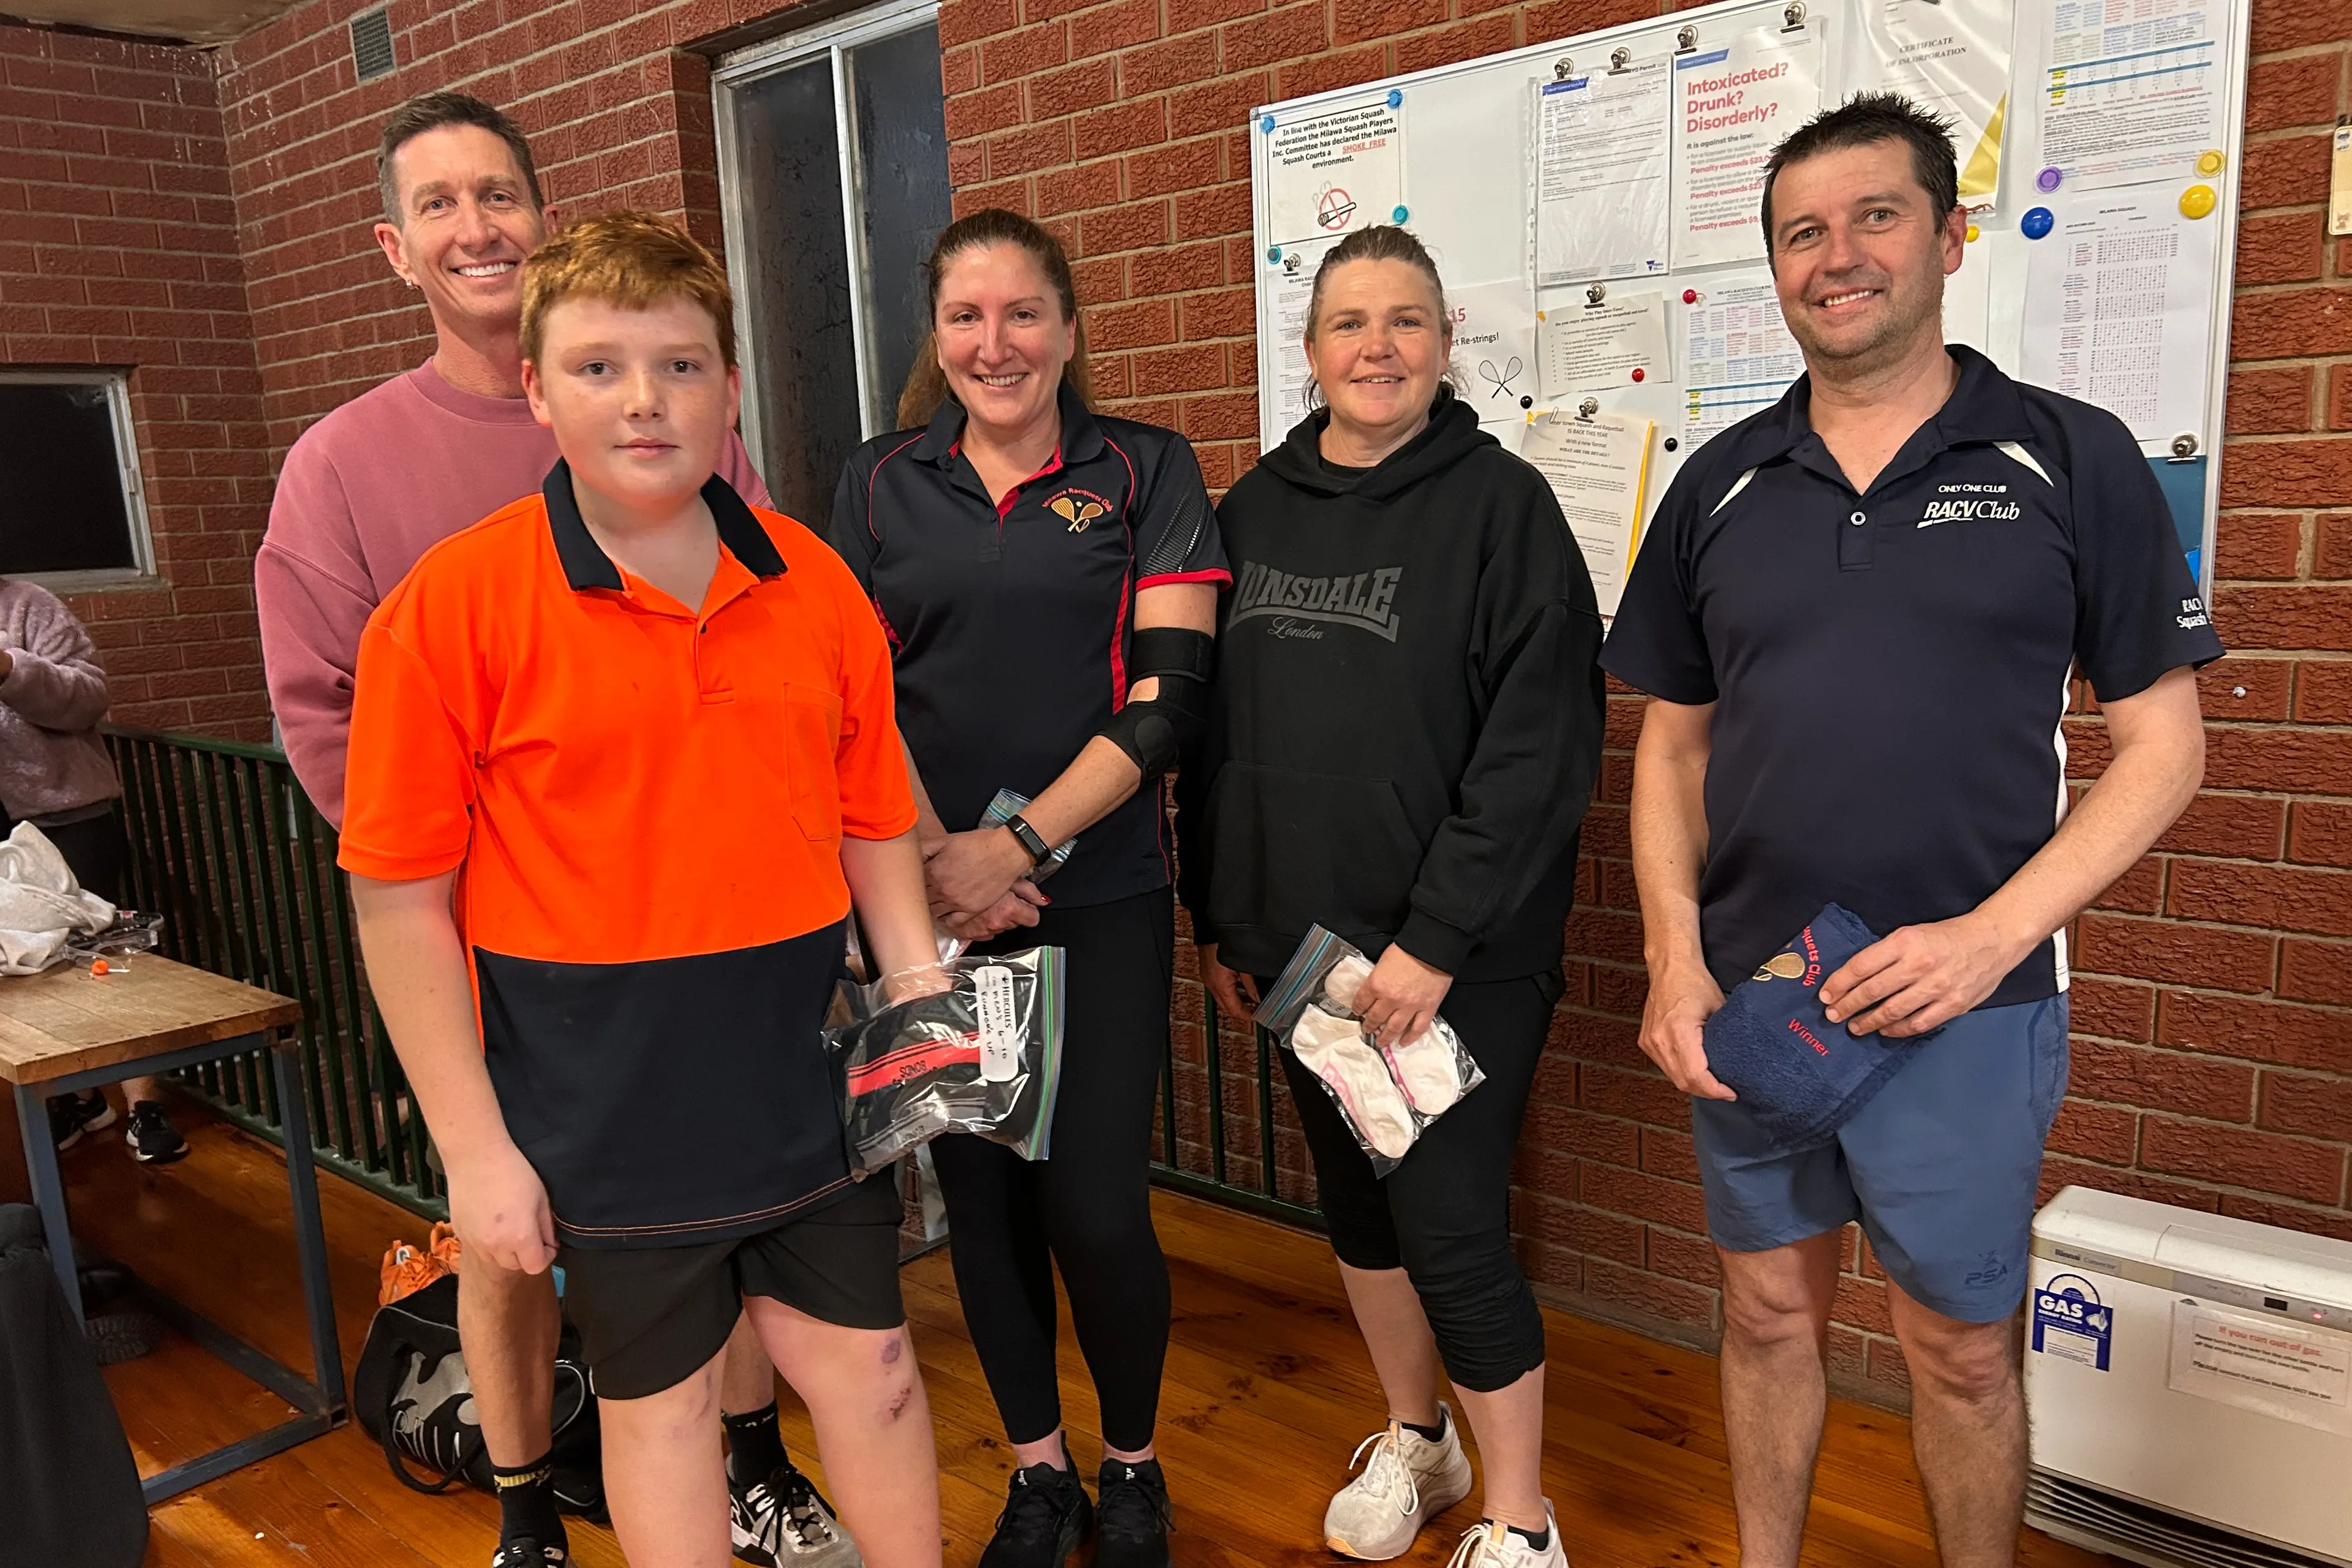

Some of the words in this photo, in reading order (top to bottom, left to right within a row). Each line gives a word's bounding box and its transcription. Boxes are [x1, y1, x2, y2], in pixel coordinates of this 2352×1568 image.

[1899, 37, 1954, 53] CERTIFICATE
[1899, 47, 1967, 65] INCORPORATION
[1687, 62, 1789, 96] Intoxicated?
[1687, 91, 1743, 115] Drunk?
[1330, 115, 1359, 126] Victorian
[1360, 108, 1384, 119] Squash
[1687, 102, 1777, 133] Disorderly?
[1275, 136, 1307, 147] Federation
[1321, 129, 1342, 138] Milawa
[1344, 123, 1367, 133] Squash
[1370, 117, 1393, 129] Players
[1286, 143, 1318, 155] Committee
[1332, 134, 1359, 145] declared
[1374, 127, 1396, 137] Milawa
[1700, 137, 1726, 148] against
[1283, 155, 1304, 165] Squash
[1306, 151, 1326, 160] Courts
[1343, 142, 1366, 153] SMOKE
[1370, 138, 1385, 148] FREE
[1312, 155, 1354, 168] environment.
[1691, 165, 1719, 174] Penalty
[1720, 159, 1748, 169] exceeds
[1691, 190, 1718, 199] Penalty
[1720, 185, 1747, 195] exceeds
[1690, 222, 1718, 232] Penalty
[1719, 218, 1747, 228] exceeds
[1461, 332, 1499, 345] Re-strings!
[1939, 484, 1962, 493] ONLY
[1962, 484, 1982, 492] ONE
[1983, 484, 2007, 493] CLUB
[1924, 500, 1978, 519] RACV
[1976, 501, 2020, 520] Club
[1228, 560, 1403, 630] LONSDALE
[1267, 616, 1324, 639] London
[1803, 964, 1821, 987] Club
[1002, 986, 1012, 1029] HERCULES
[1788, 1018, 1830, 1057] Winner
[2039, 1295, 2083, 1317] GAS
[2228, 1329, 2247, 1339] you
[2249, 1334, 2267, 1344] run
[2269, 1339, 2287, 1349] out
